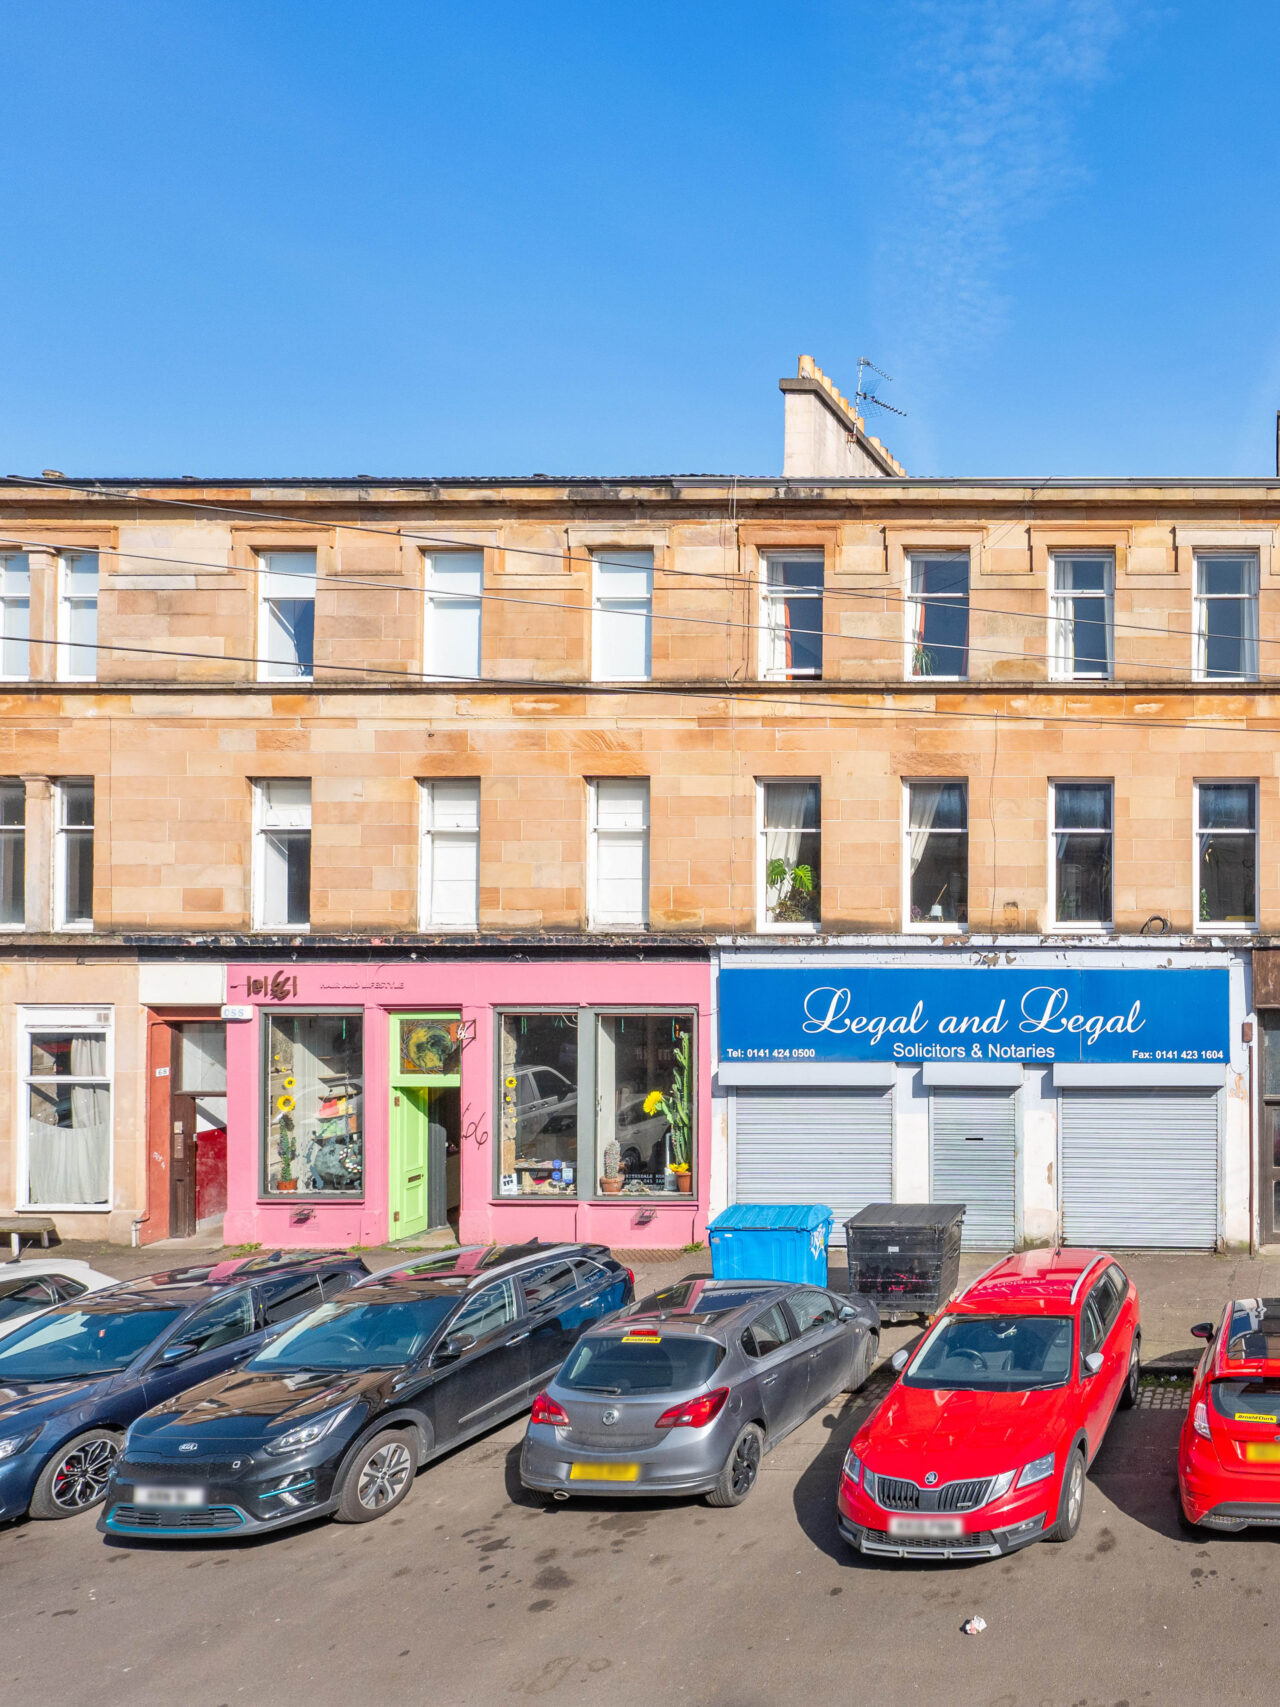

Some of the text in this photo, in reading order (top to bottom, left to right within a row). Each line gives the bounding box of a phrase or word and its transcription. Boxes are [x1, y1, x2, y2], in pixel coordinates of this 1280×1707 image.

[802, 986, 1147, 1046] Legal and Legal
[727, 1048, 816, 1058] Tel: 0141 424 0500
[893, 1042, 1056, 1058] Solicitors & Notaries
[1132, 1050, 1224, 1059] Fax: 0141 423 1604
